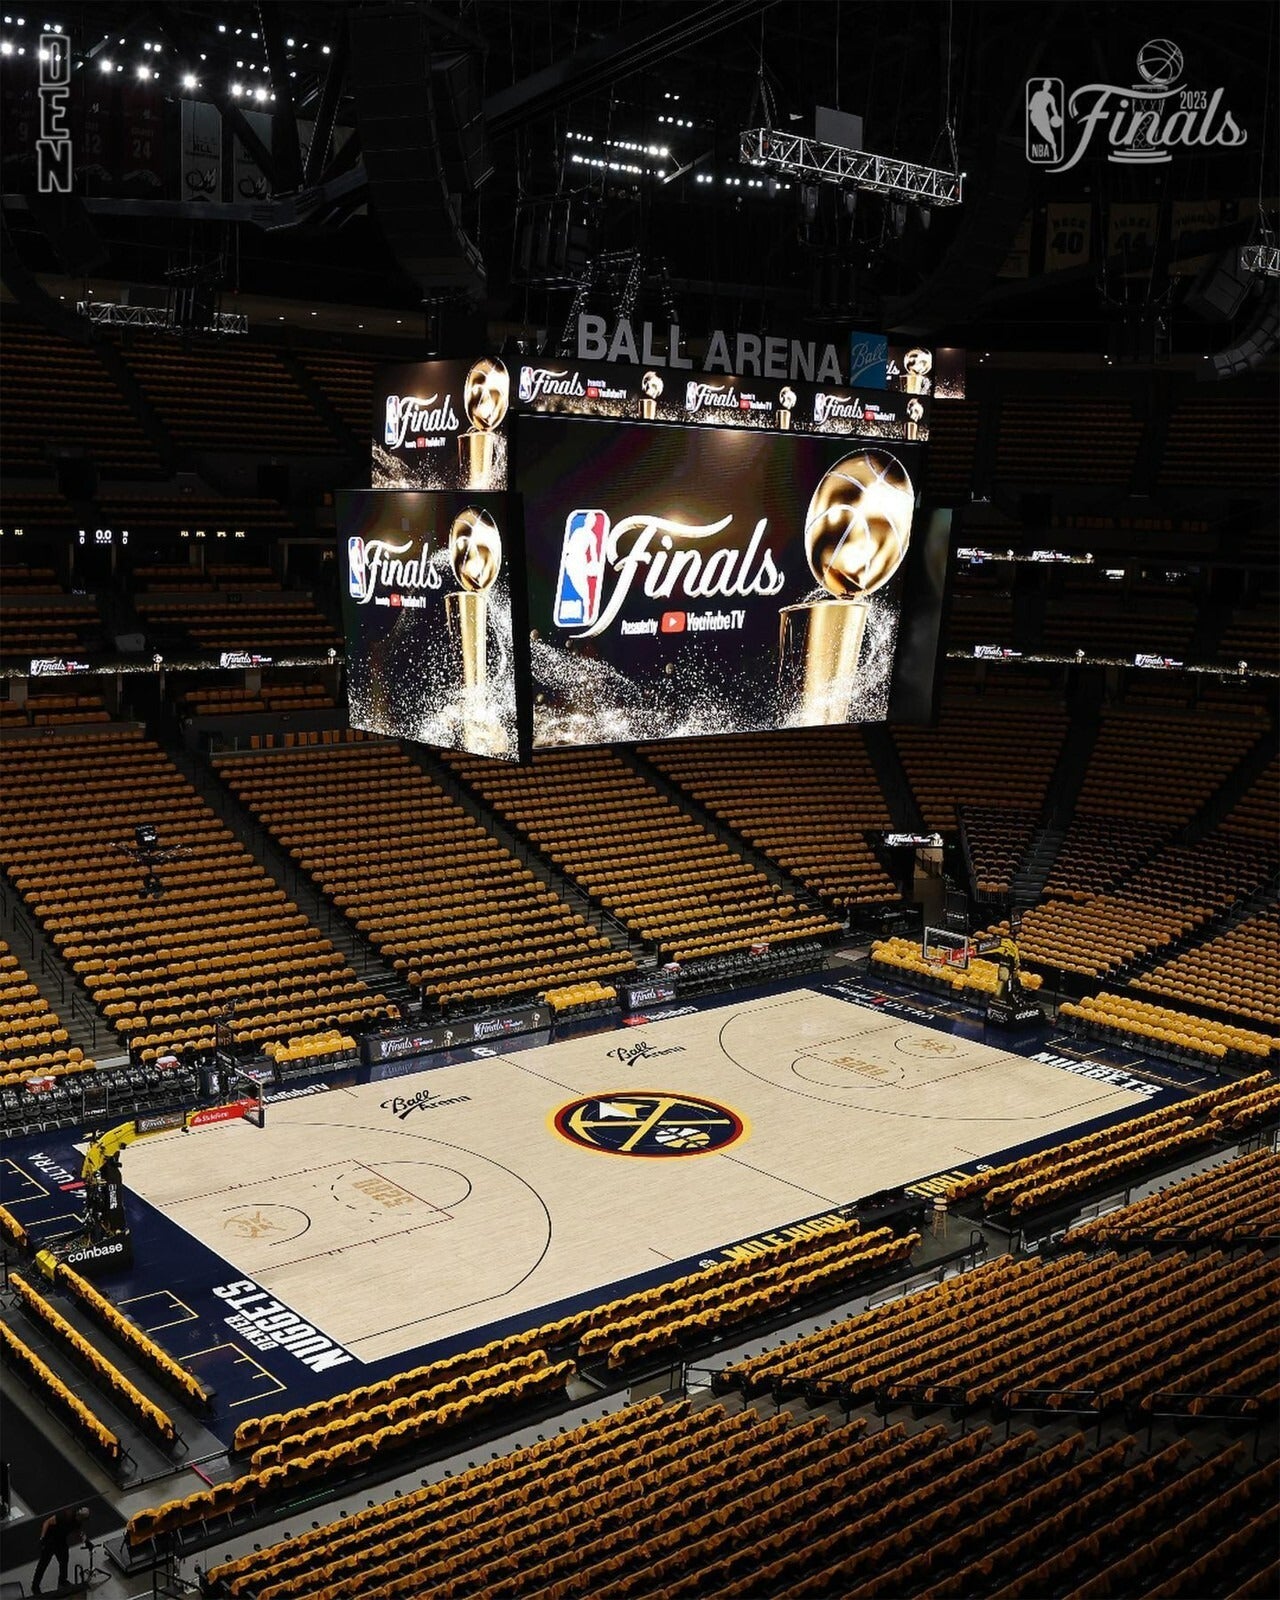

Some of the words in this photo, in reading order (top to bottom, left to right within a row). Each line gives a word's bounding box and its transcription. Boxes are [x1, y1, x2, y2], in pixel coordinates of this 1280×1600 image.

[1052, 231, 1083, 253] 40
[577, 313, 693, 370] BALL
[702, 329, 843, 385] ARENA
[851, 340, 888, 371] Ball
[525, 368, 586, 403] Finals
[689, 383, 739, 413] Finals
[390, 393, 459, 450] Finals
[815, 395, 864, 425] Finals
[95, 530, 112, 540] 0.0
[356, 540, 442, 605] Finals
[568, 513, 785, 639] Finals
[36, 657, 66, 676] Finals
[606, 1041, 647, 1062] Ball
[1029, 1051, 1164, 1096] NUGGETS
[380, 1090, 430, 1114] Ball
[28, 1152, 75, 1184] ULTRA
[68, 1243, 123, 1262] coinbase
[720, 1233, 786, 1262] MILE
[212, 1280, 354, 1373] NUGGETS
